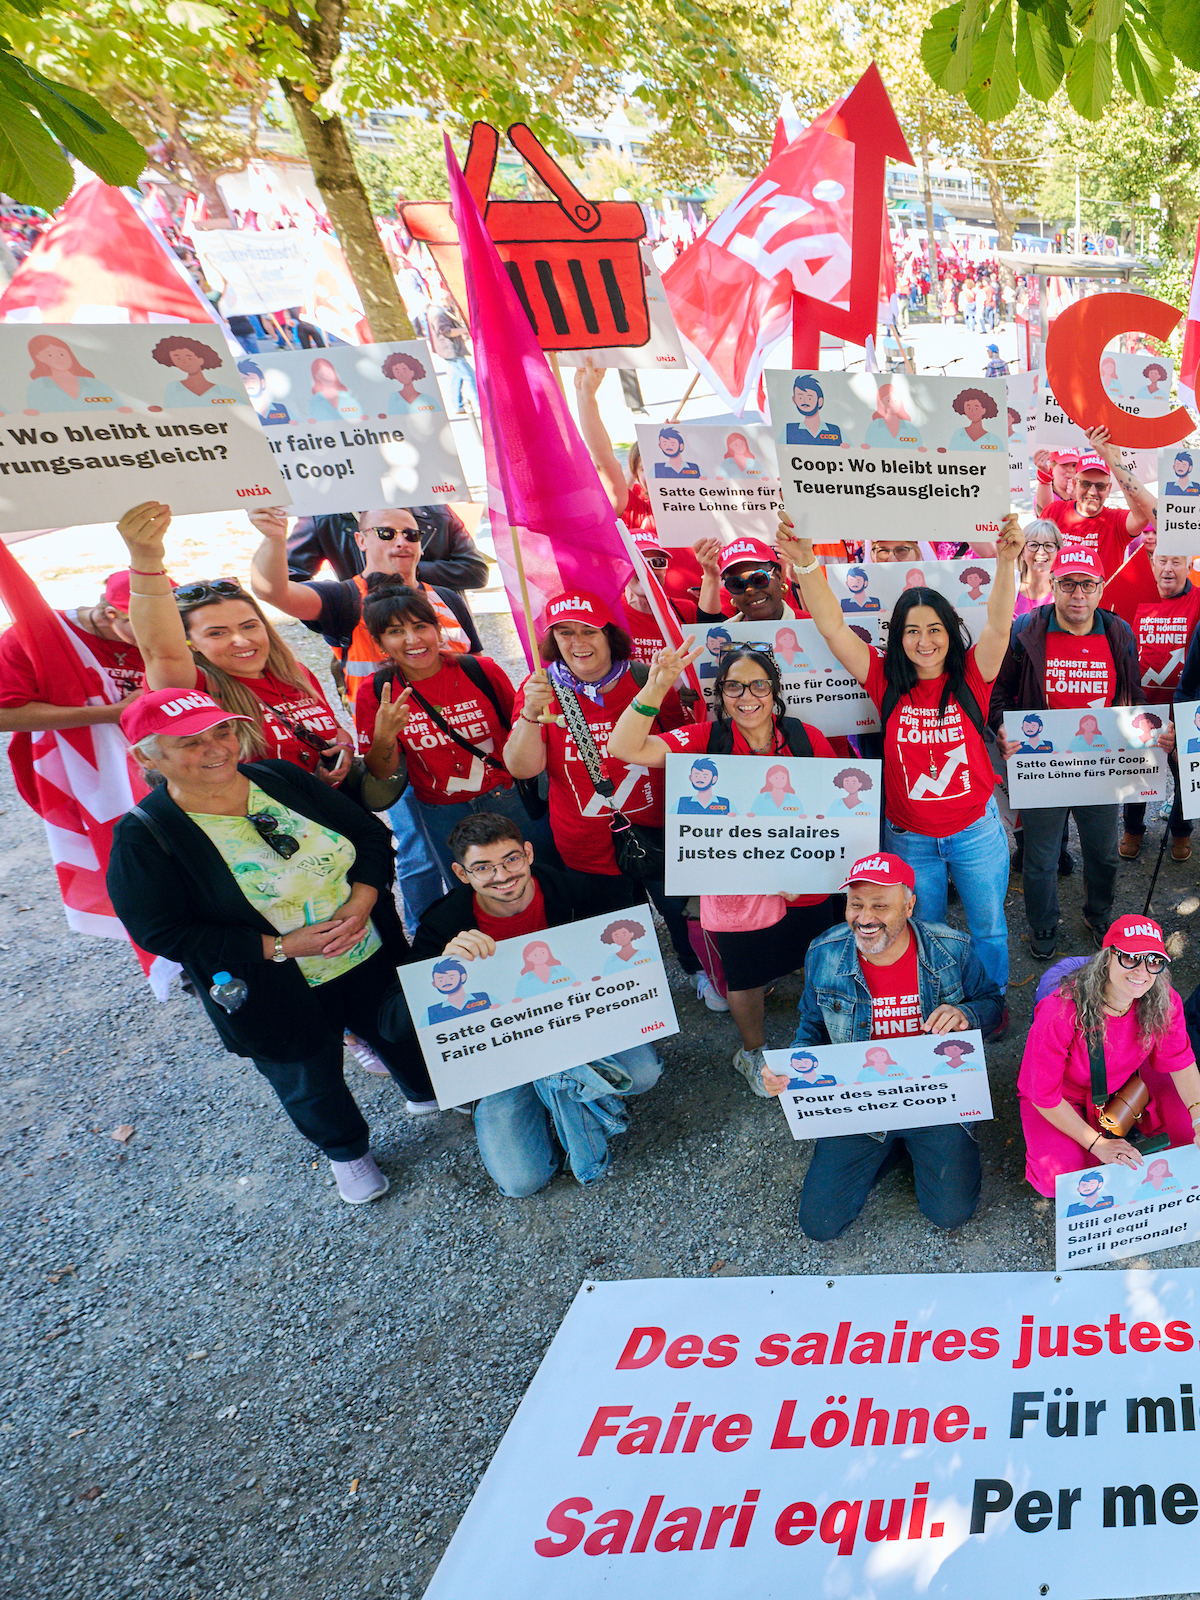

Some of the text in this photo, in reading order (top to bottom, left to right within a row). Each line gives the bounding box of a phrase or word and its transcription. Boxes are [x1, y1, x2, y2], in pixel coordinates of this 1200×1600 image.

[6, 422, 228, 446] Wo bleibt unser
[791, 456, 987, 476] Coop: Wo bleibt unser
[659, 486, 776, 497] Satte Gewinne für
[793, 479, 980, 500] Teuerungsausgleich?
[662, 501, 767, 512] Faire Löhne fürs
[1166, 503, 1196, 514] Pour
[1046, 658, 1107, 669] HÖCHSTE ZEIT
[1046, 668, 1108, 679] FÜR HÖHERE
[1046, 678, 1109, 694] LÖHNE!
[1016, 756, 1150, 769] Satte Gewinne für Coop.
[1017, 765, 1159, 780] Faire Löhne fürs Personal!
[679, 824, 840, 839] Pour des salaires
[677, 846, 738, 862] justes
[742, 846, 785, 860] chez
[435, 980, 640, 1045] Satte Gewinne für Coop.
[441, 987, 659, 1063] Faire Löhne fürs Personal!
[792, 1082, 949, 1105] Pour des salaires
[797, 1106, 853, 1120] justes
[857, 1101, 899, 1112] chez
[1068, 1217, 1099, 1232] Utili
[1103, 1204, 1154, 1224] elevati
[1158, 1199, 1183, 1213] per
[1068, 1218, 1148, 1245] Salari equi
[1068, 1222, 1188, 1259] per il personale!
[615, 1326, 741, 1370] Des
[754, 1319, 1000, 1367] salaires
[577, 1401, 753, 1457] Faire
[769, 1394, 987, 1450] Löhne.
[1009, 1387, 1107, 1439] Für
[534, 1489, 761, 1558] Salari
[774, 1481, 945, 1556] equi.
[969, 1478, 1082, 1535] Per
[1102, 1482, 1199, 1528] me
